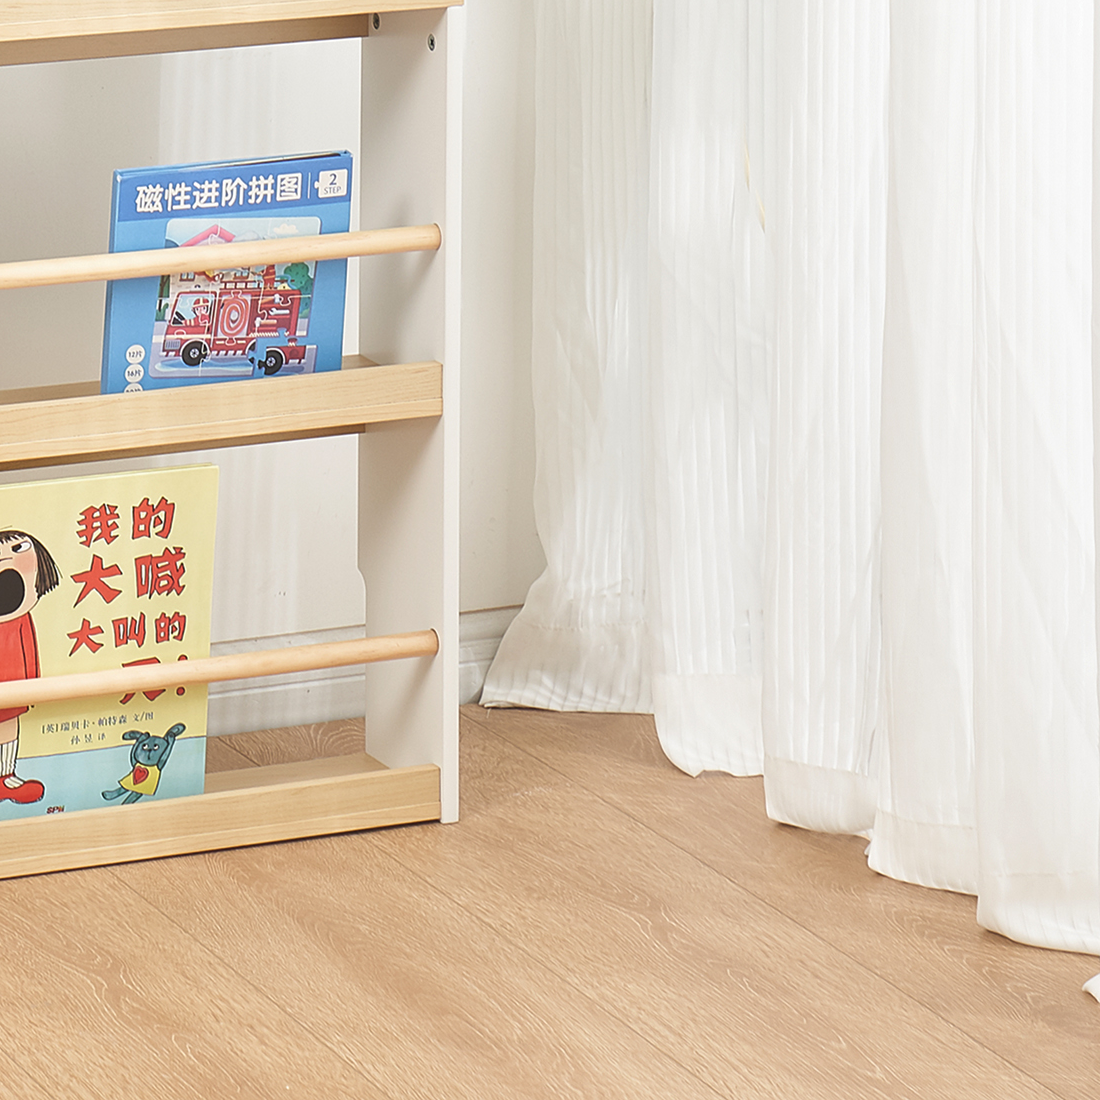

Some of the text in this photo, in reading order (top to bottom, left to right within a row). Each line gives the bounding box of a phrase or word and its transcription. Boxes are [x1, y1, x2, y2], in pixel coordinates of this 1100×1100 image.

[135, 172, 302, 213] 磁性进阶拼图
[323, 185, 342, 195] STEP
[329, 173, 337, 185] 2
[76, 496, 176, 548] 我的
[70, 546, 187, 608] 大喊
[67, 611, 187, 657] 大叫的
